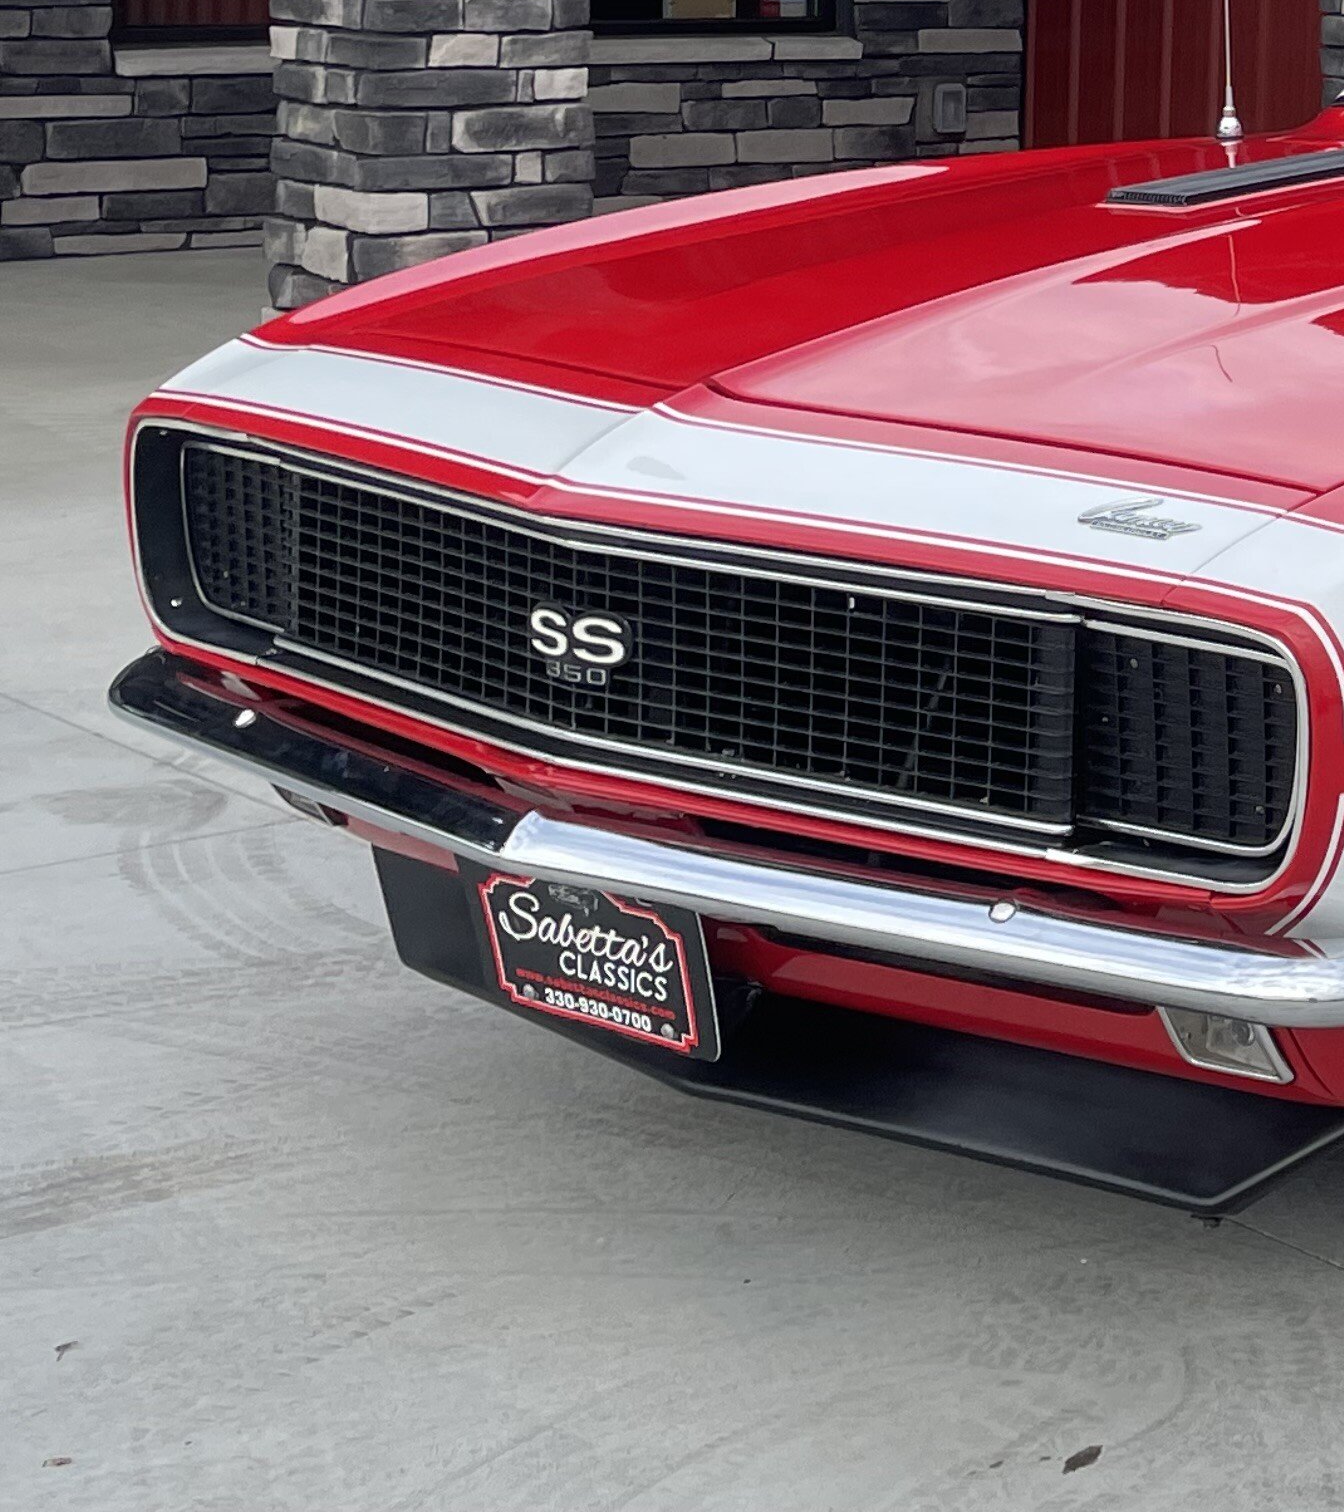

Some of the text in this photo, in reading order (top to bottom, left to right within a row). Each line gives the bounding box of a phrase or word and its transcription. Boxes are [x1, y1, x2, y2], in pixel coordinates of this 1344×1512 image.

[529, 607, 627, 665] SS
[545, 660, 607, 687] 350
[497, 890, 675, 974] Sabetta's
[558, 949, 669, 1003] CLASSICS
[543, 986, 653, 1033] 330-930-0700
